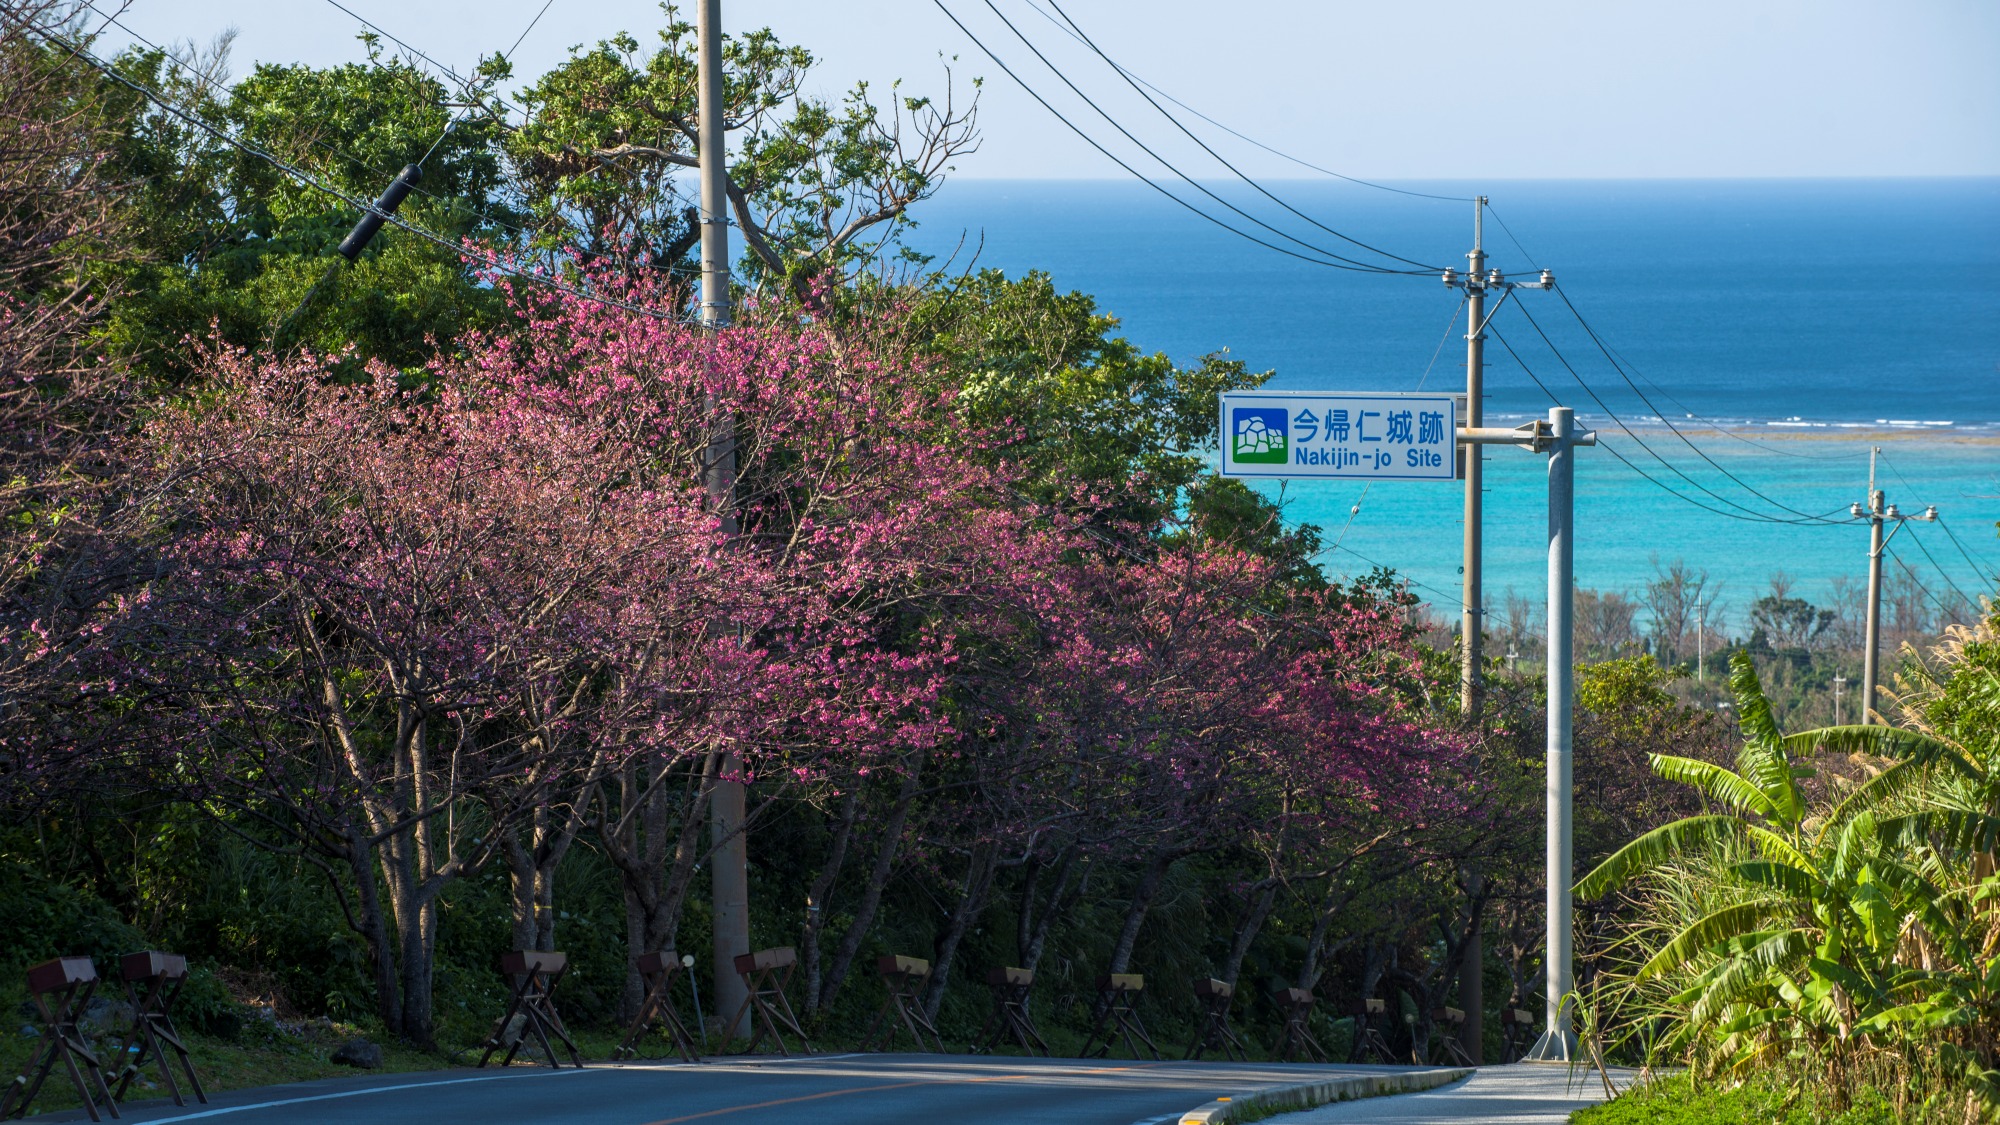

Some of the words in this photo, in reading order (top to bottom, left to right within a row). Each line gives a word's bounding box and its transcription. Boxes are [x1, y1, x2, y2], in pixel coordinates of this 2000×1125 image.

[1294, 408, 1444, 445] 今帰仁城跡
[1295, 447, 1392, 470] Nakijin-jo
[1406, 448, 1442, 468] Site
